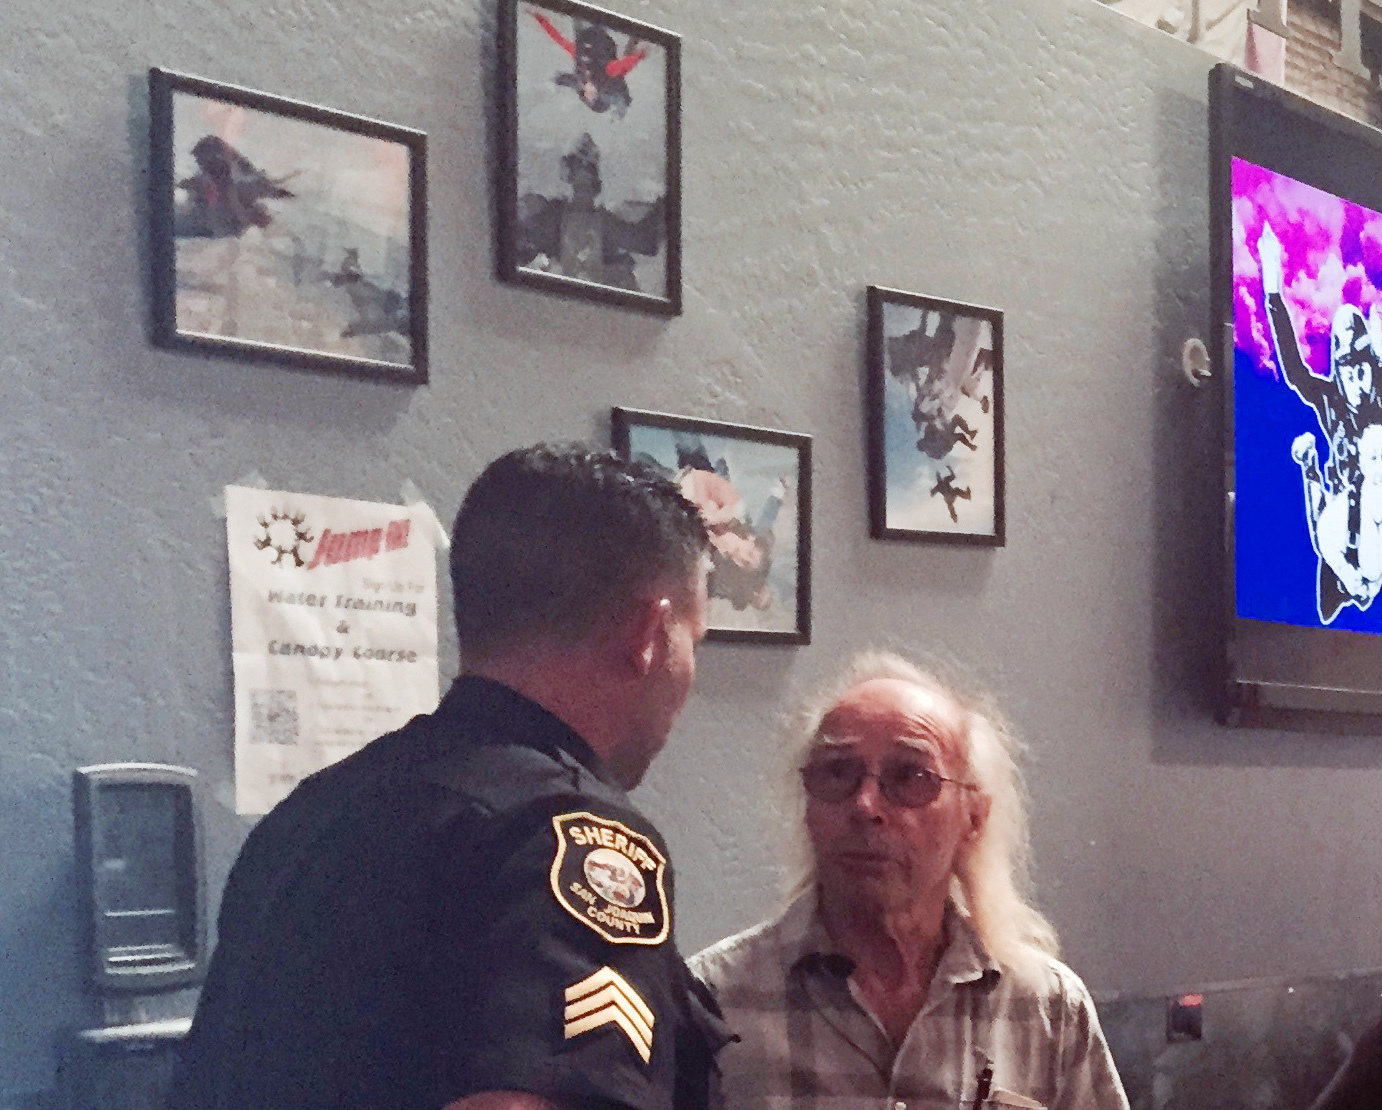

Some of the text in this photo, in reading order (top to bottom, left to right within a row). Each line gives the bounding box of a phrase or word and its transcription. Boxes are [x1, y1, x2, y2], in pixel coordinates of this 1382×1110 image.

[336, 595, 417, 617] Training
[267, 640, 418, 663] Canopy Course
[569, 826, 657, 872] SHERIFF
[587, 906, 640, 935] COUNTY
